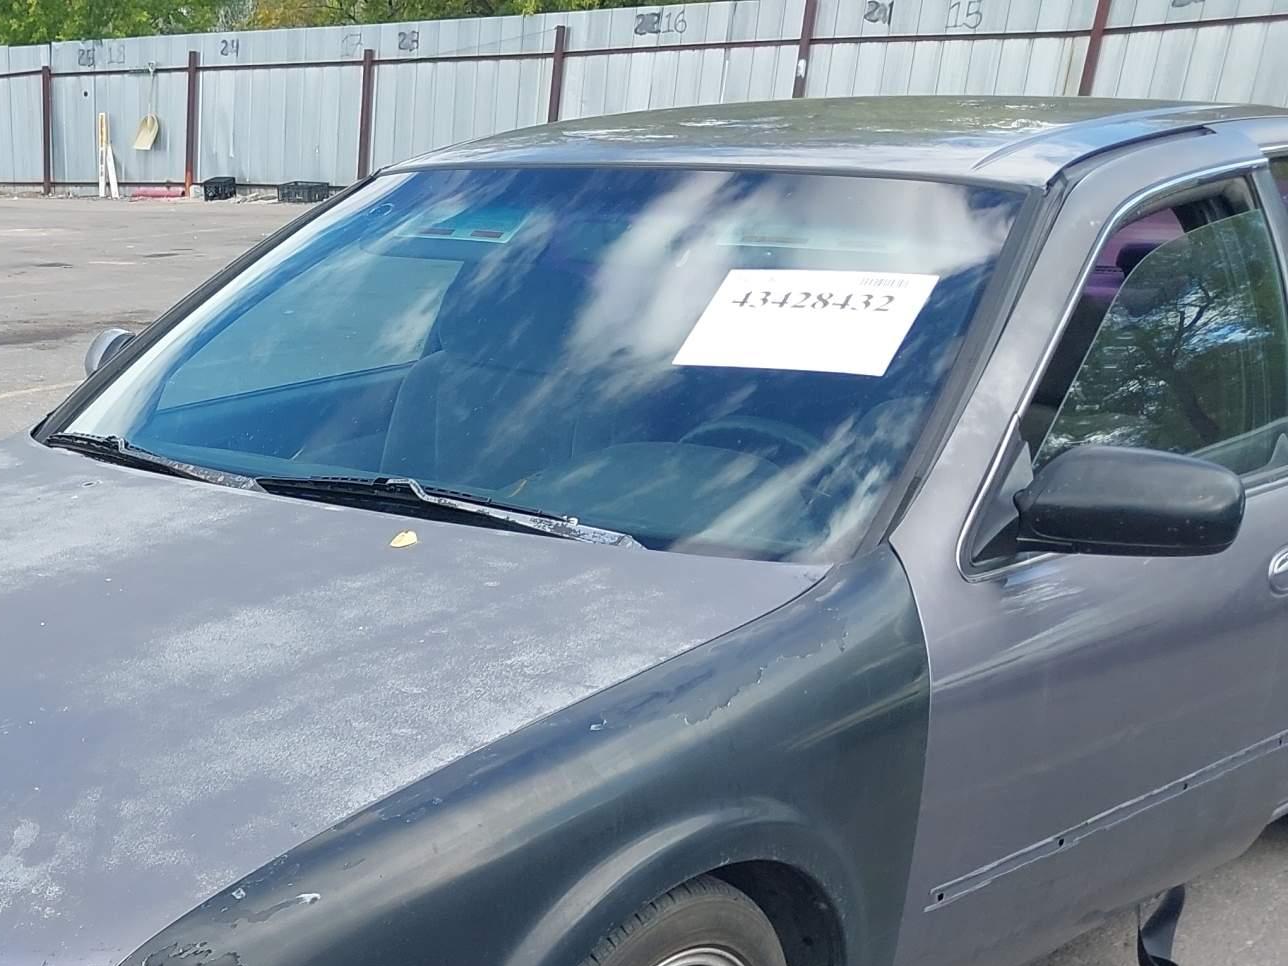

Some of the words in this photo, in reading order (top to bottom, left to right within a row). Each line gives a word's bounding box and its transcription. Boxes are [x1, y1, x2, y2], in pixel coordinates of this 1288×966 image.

[944, 0, 984, 29] 15
[220, 38, 240, 58] 24
[731, 290, 896, 312] 43428432
